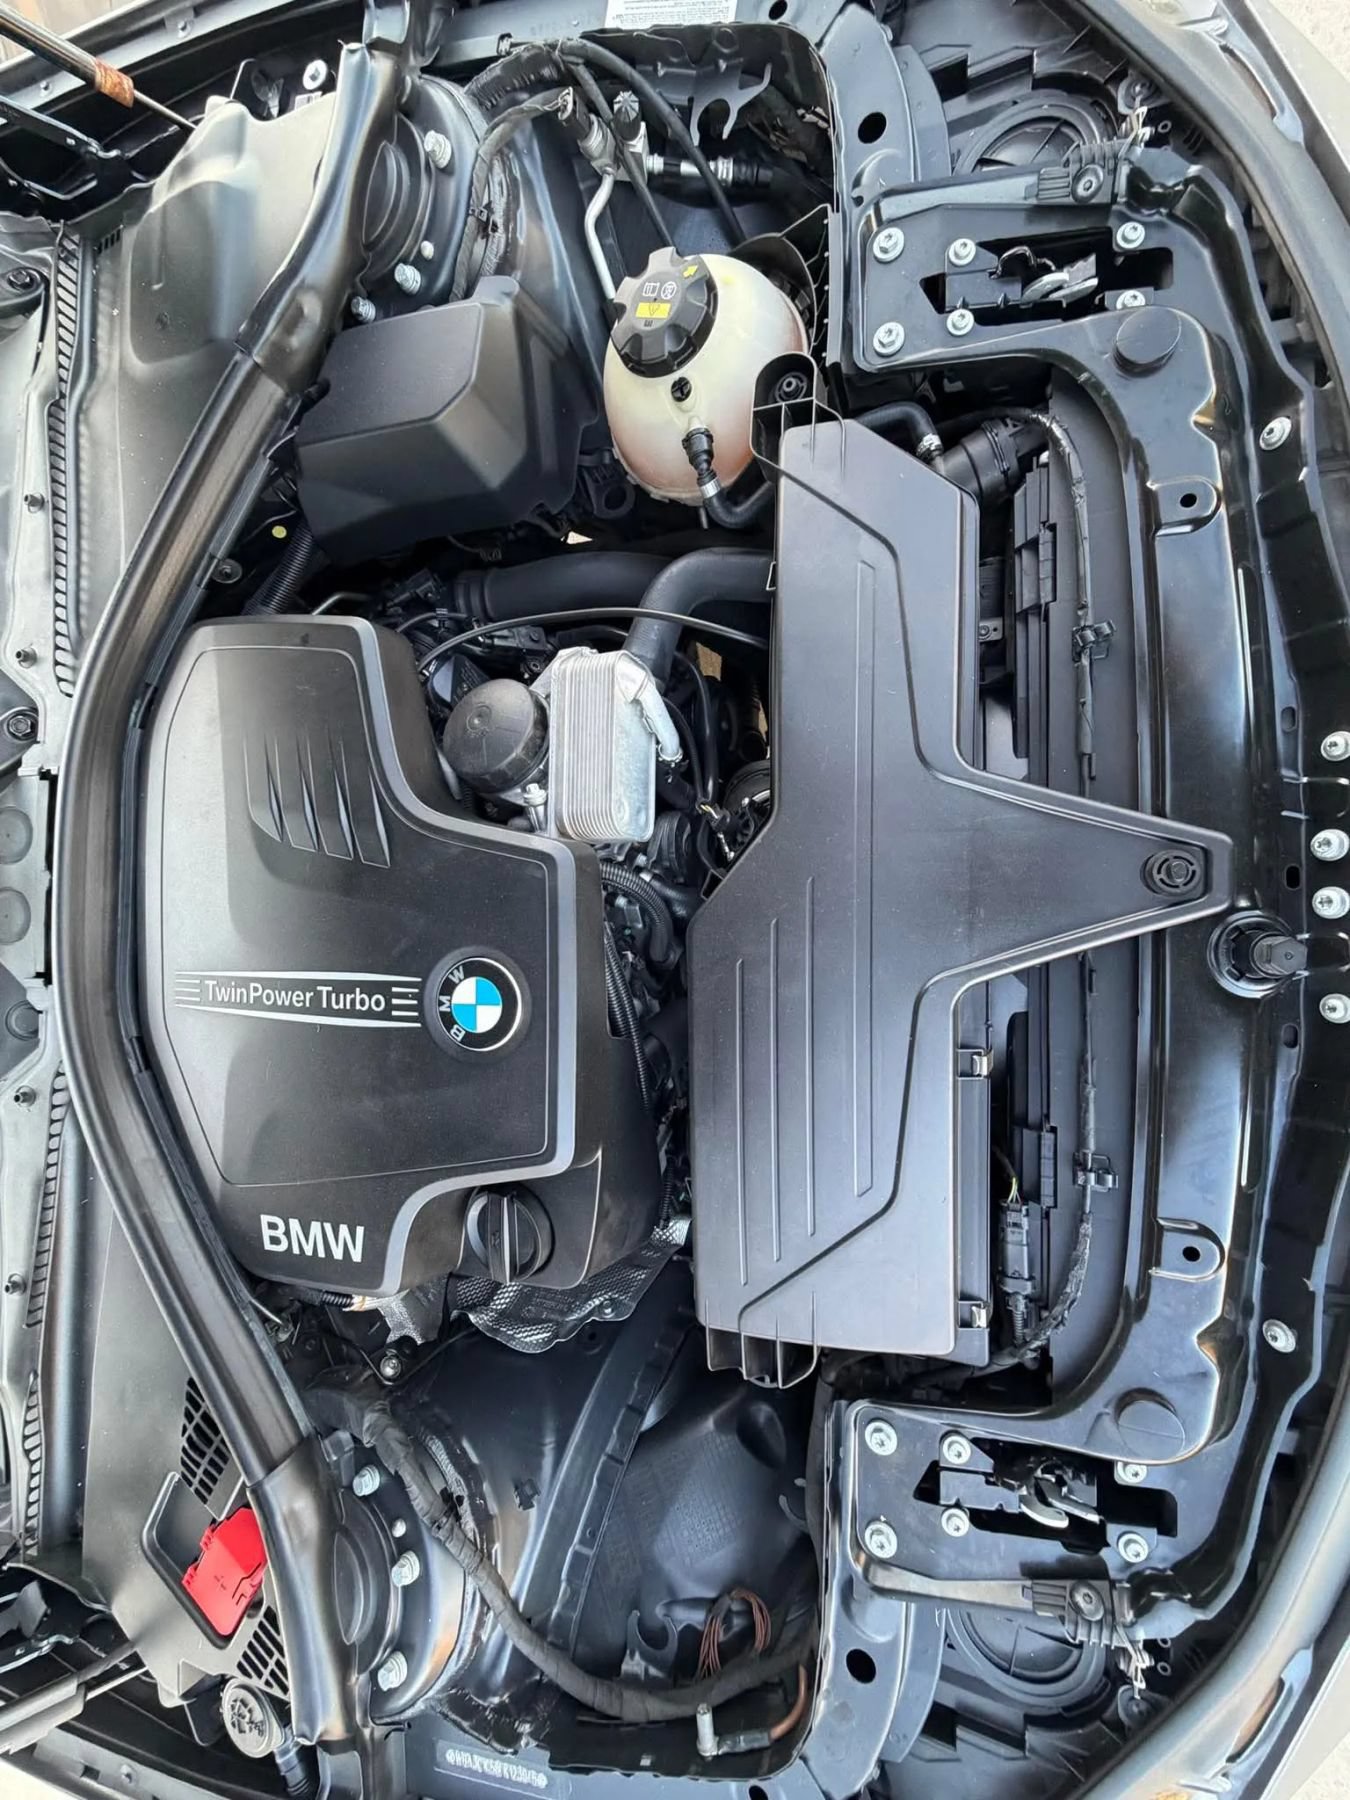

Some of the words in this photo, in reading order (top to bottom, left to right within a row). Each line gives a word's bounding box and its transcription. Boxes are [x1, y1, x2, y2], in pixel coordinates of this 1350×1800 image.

[316, 985, 386, 1013] Turbo
[438, 965, 465, 1043] BMW
[260, 1213, 365, 1263] BMW
